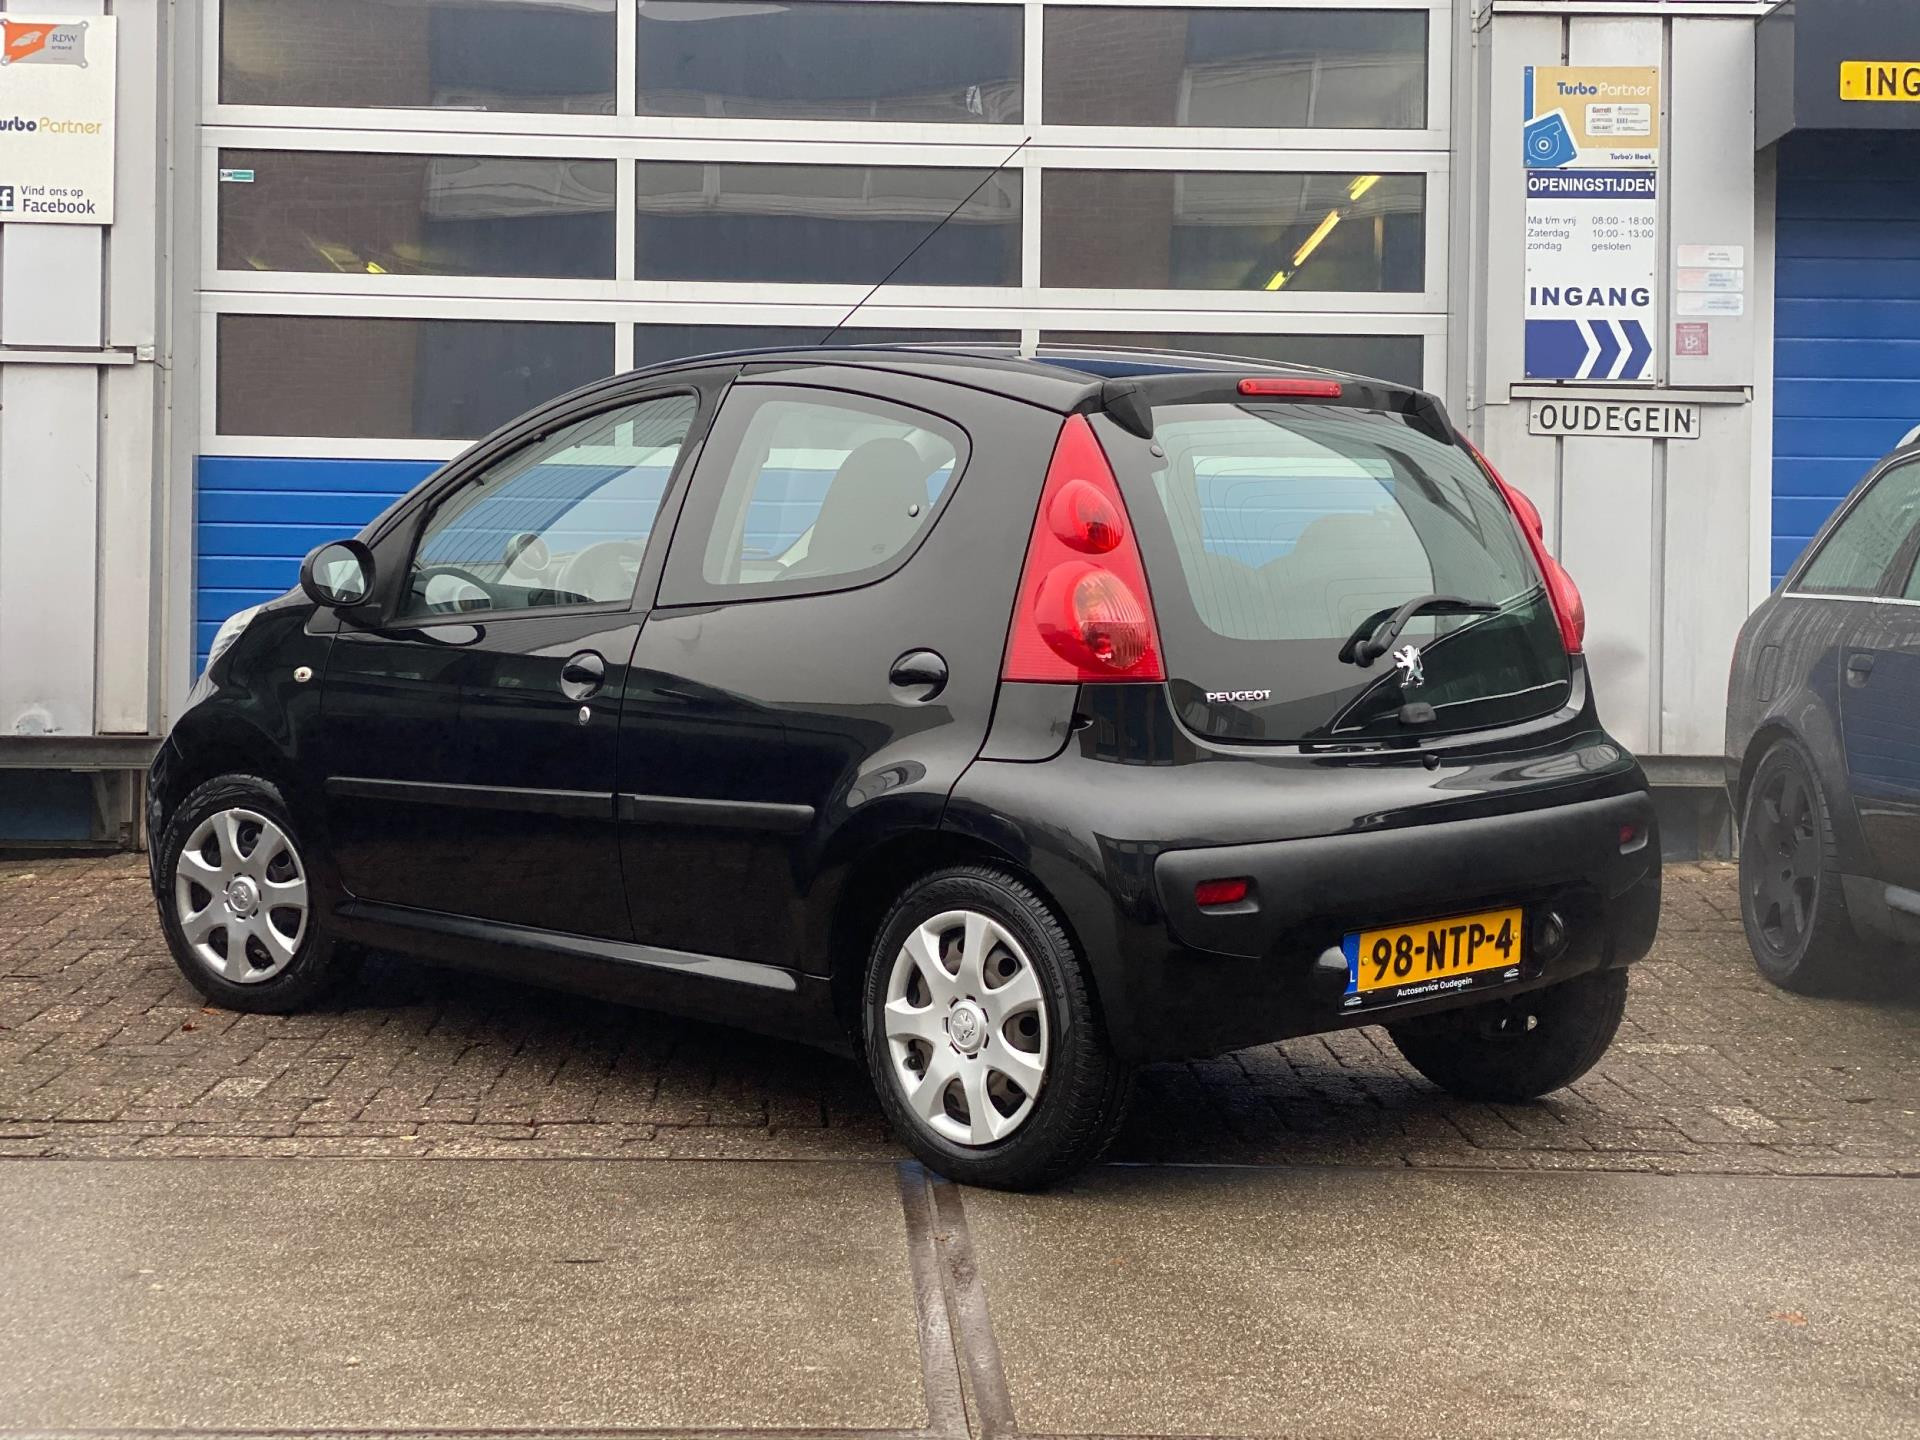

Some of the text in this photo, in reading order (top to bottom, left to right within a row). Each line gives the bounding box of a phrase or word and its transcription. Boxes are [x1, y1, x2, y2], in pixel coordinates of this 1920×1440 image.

[52, 34, 77, 43] RDW
[1866, 67, 1920, 96] ING
[1557, 82, 1652, 96] Turbo Partner
[39, 117, 102, 134] Partner
[1528, 178, 1655, 192] OPENINGSTIJDEN
[20, 186, 45, 195] Vind
[49, 188, 68, 197] ons
[70, 189, 84, 199] op
[23, 199, 96, 215] Facebook
[1528, 216, 1543, 225] Ma
[1562, 216, 1576, 227] vrij
[1592, 216, 1619, 225] 08:00
[1628, 216, 1654, 226] 18:00
[1528, 229, 1570, 240] Zaterdag
[1593, 229, 1618, 238] 10:00
[1628, 229, 1654, 238] 13:00
[1527, 241, 1632, 252] zondag gesloten
[1530, 287, 1650, 306] INGANG
[1539, 404, 1691, 433] OUDEGEIN
[1205, 689, 1272, 703] PEUGEOT
[1372, 918, 1513, 981] 98-NTP-4
[1396, 976, 1473, 998] Autoservice Oudegein
